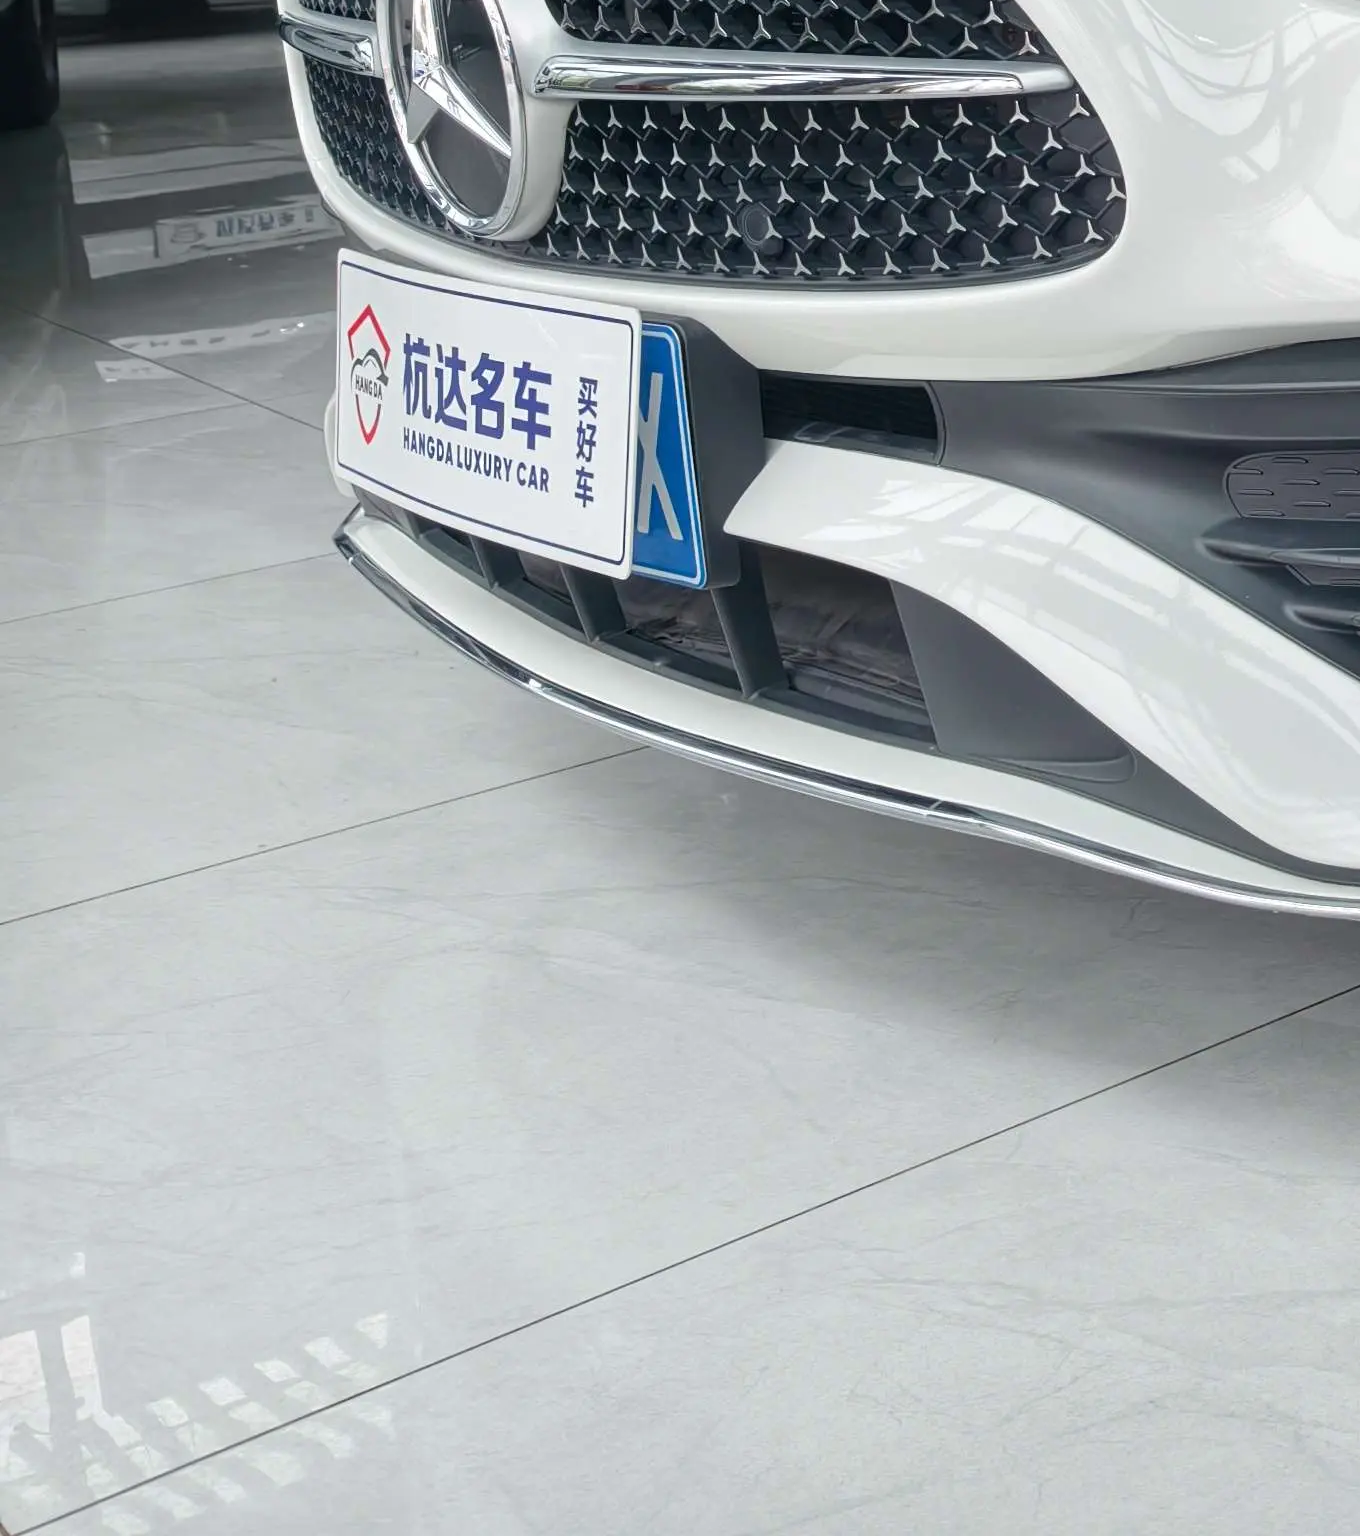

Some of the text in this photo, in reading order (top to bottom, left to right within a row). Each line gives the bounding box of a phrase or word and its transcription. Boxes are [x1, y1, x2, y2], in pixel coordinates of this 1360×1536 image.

[355, 374, 383, 400] HANG DA
[403, 333, 552, 450] 杭达名车
[403, 426, 549, 493] HANGDA LUXURY CAR
[574, 376, 599, 508] 买好车
